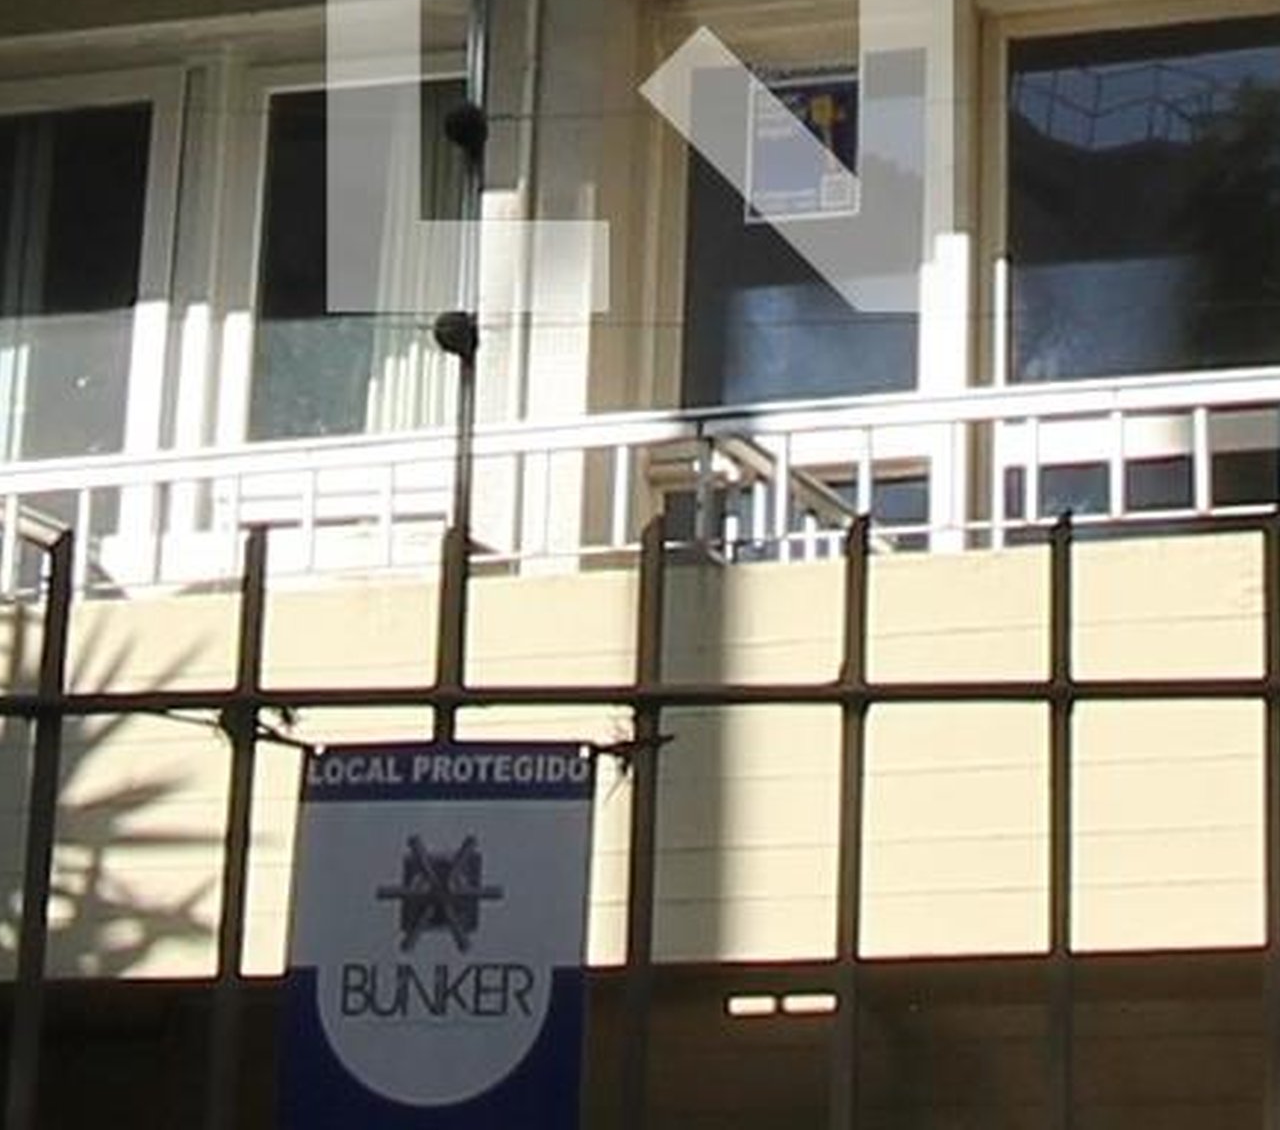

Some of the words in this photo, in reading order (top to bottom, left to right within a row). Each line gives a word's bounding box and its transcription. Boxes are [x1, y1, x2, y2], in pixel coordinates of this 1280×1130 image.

[308, 758, 402, 784] LOCAL
[412, 755, 590, 782] PROTEGIDO
[342, 964, 534, 1017] BUNKER
